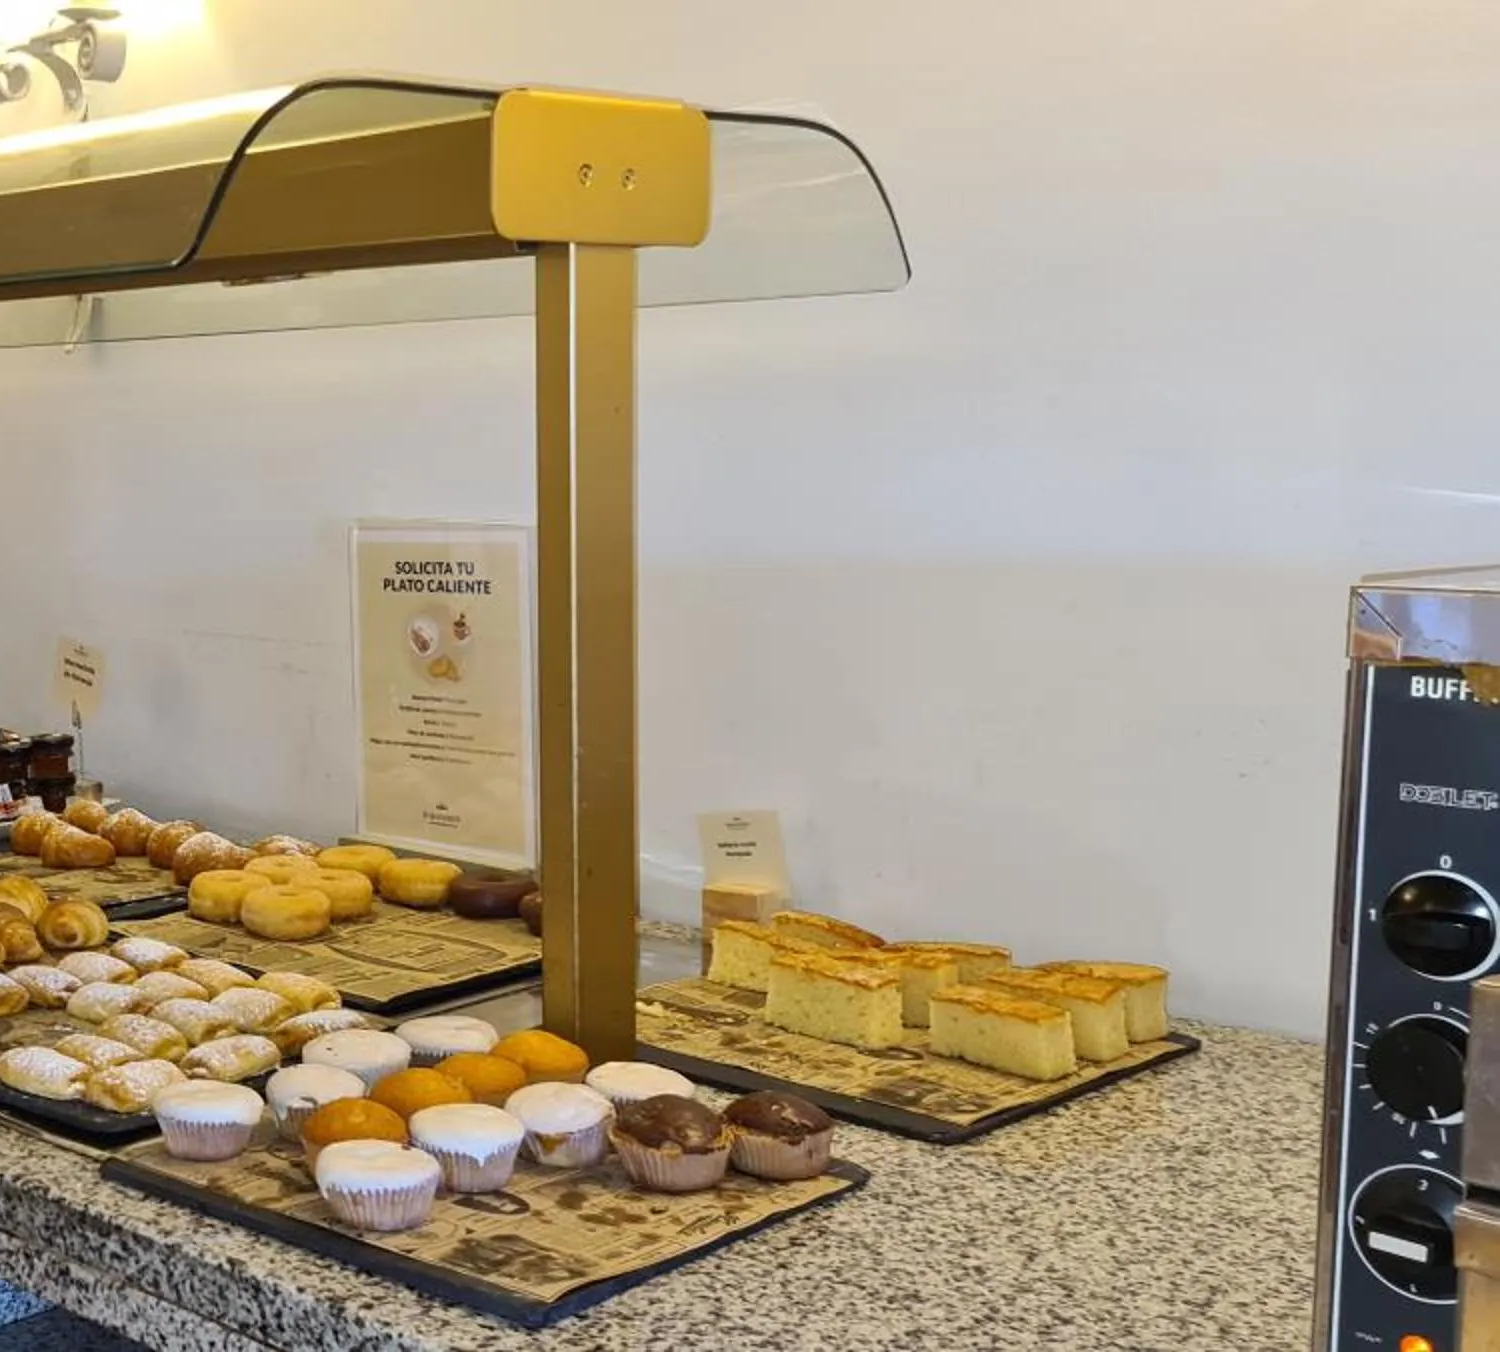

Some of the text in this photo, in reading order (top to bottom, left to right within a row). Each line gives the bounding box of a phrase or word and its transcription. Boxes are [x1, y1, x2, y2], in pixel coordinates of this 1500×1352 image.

[395, 561, 475, 576] SOLICITA TU
[383, 578, 492, 595] PLATO CALIENTE
[1410, 675, 1499, 702] BUFF
[1440, 854, 1453, 870] 0
